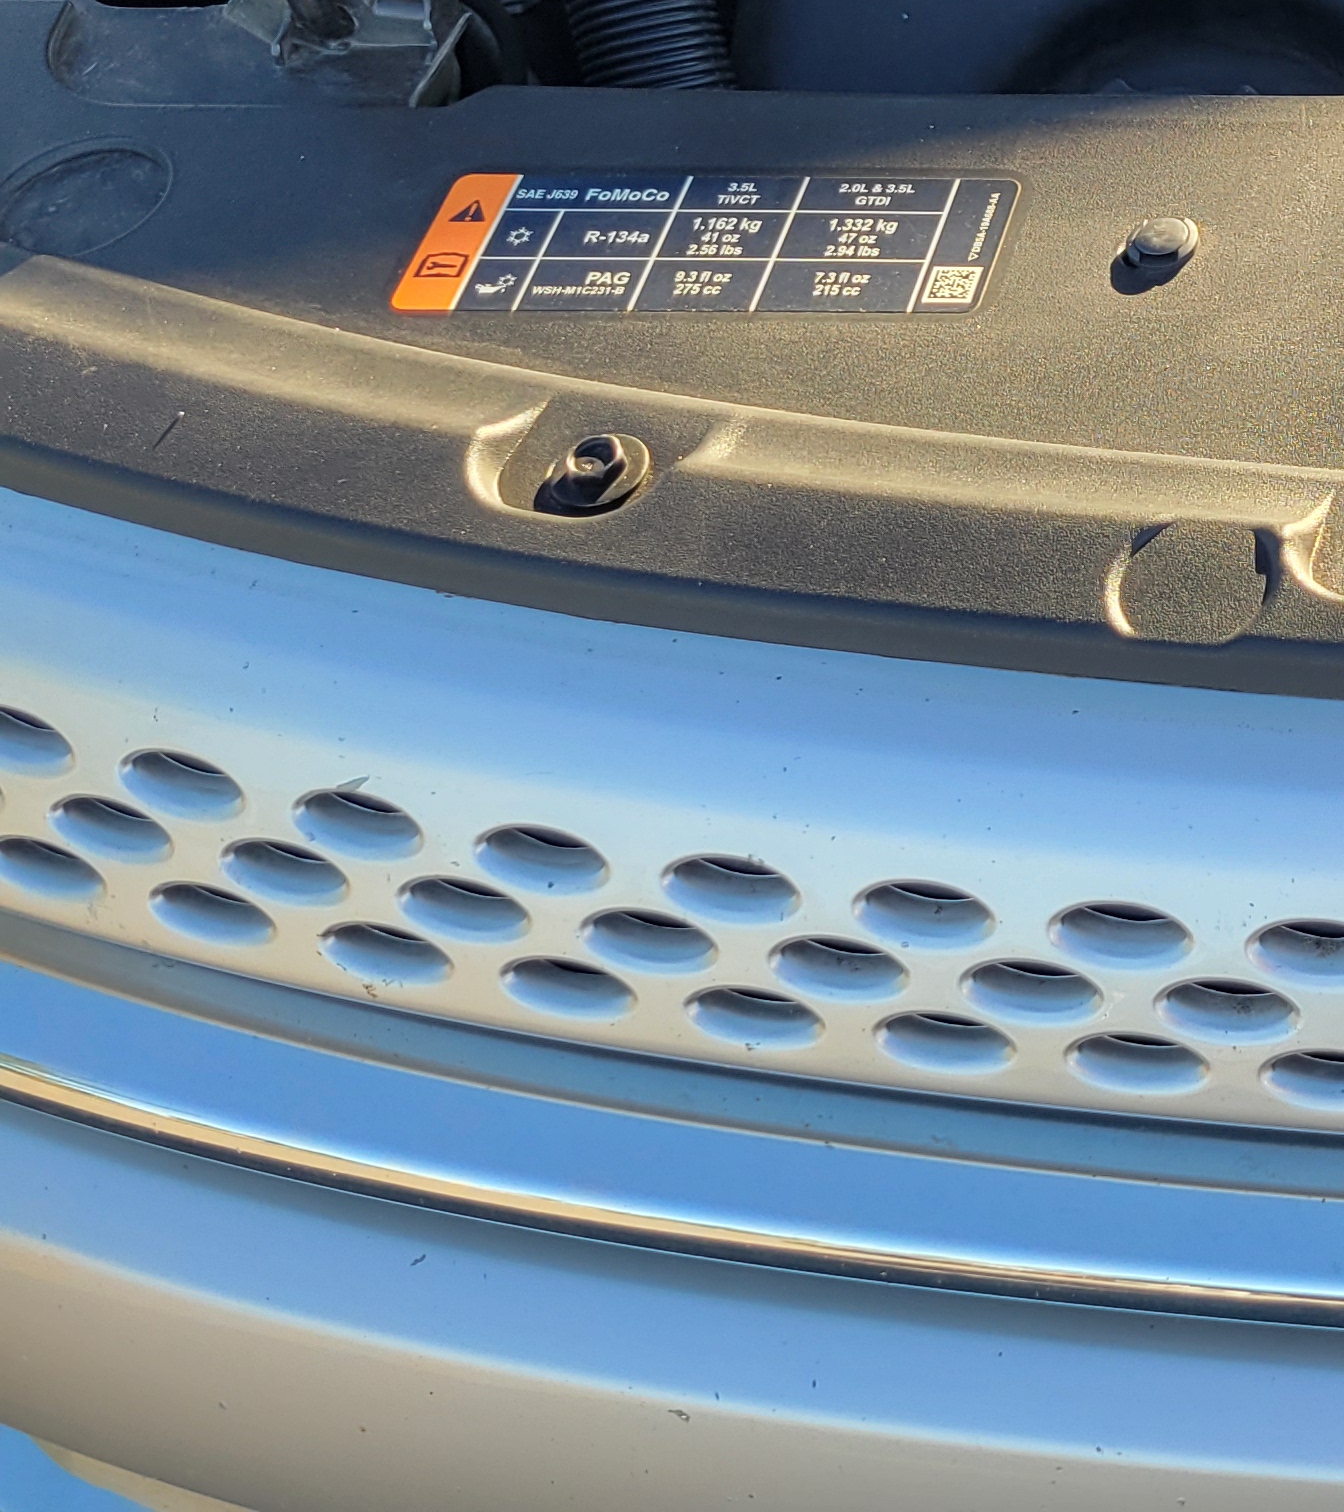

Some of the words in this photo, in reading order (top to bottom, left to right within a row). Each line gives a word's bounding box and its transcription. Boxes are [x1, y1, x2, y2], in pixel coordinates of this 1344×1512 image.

[728, 182, 757, 192] 3.5L
[838, 183, 868, 193] 2.0L
[871, 184, 883, 193] &
[885, 184, 915, 194] 3.5L
[516, 189, 544, 199] SAE
[547, 189, 578, 200] J639
[585, 188, 670, 201] FoMoCo
[855, 196, 891, 206] GTDI
[693, 217, 737, 231] 1.162
[740, 217, 762, 233] kg
[829, 218, 872, 232] 1.332
[876, 219, 898, 234] kg
[583, 230, 650, 244] R-134a
[701, 232, 719, 243] 41
[722, 233, 741, 243] oz
[838, 233, 857, 244] 47
[859, 234, 877, 244] oz
[686, 244, 718, 256] 2.56
[720, 244, 743, 256] lbs
[824, 245, 855, 257] 2.94
[857, 245, 880, 257] lbs
[585, 271, 631, 285] PAG
[674, 271, 698, 283] 9.3
[699, 270, 712, 283] fl
[713, 273, 733, 283] oz
[814, 271, 837, 284] 7.3
[838, 271, 851, 284] fl
[852, 273, 871, 284] oz
[532, 286, 626, 297] WSH-M1C231-B
[673, 283, 701, 296] 275
[703, 285, 722, 295] cc
[813, 284, 842, 296] 215
[843, 286, 861, 296] cc
